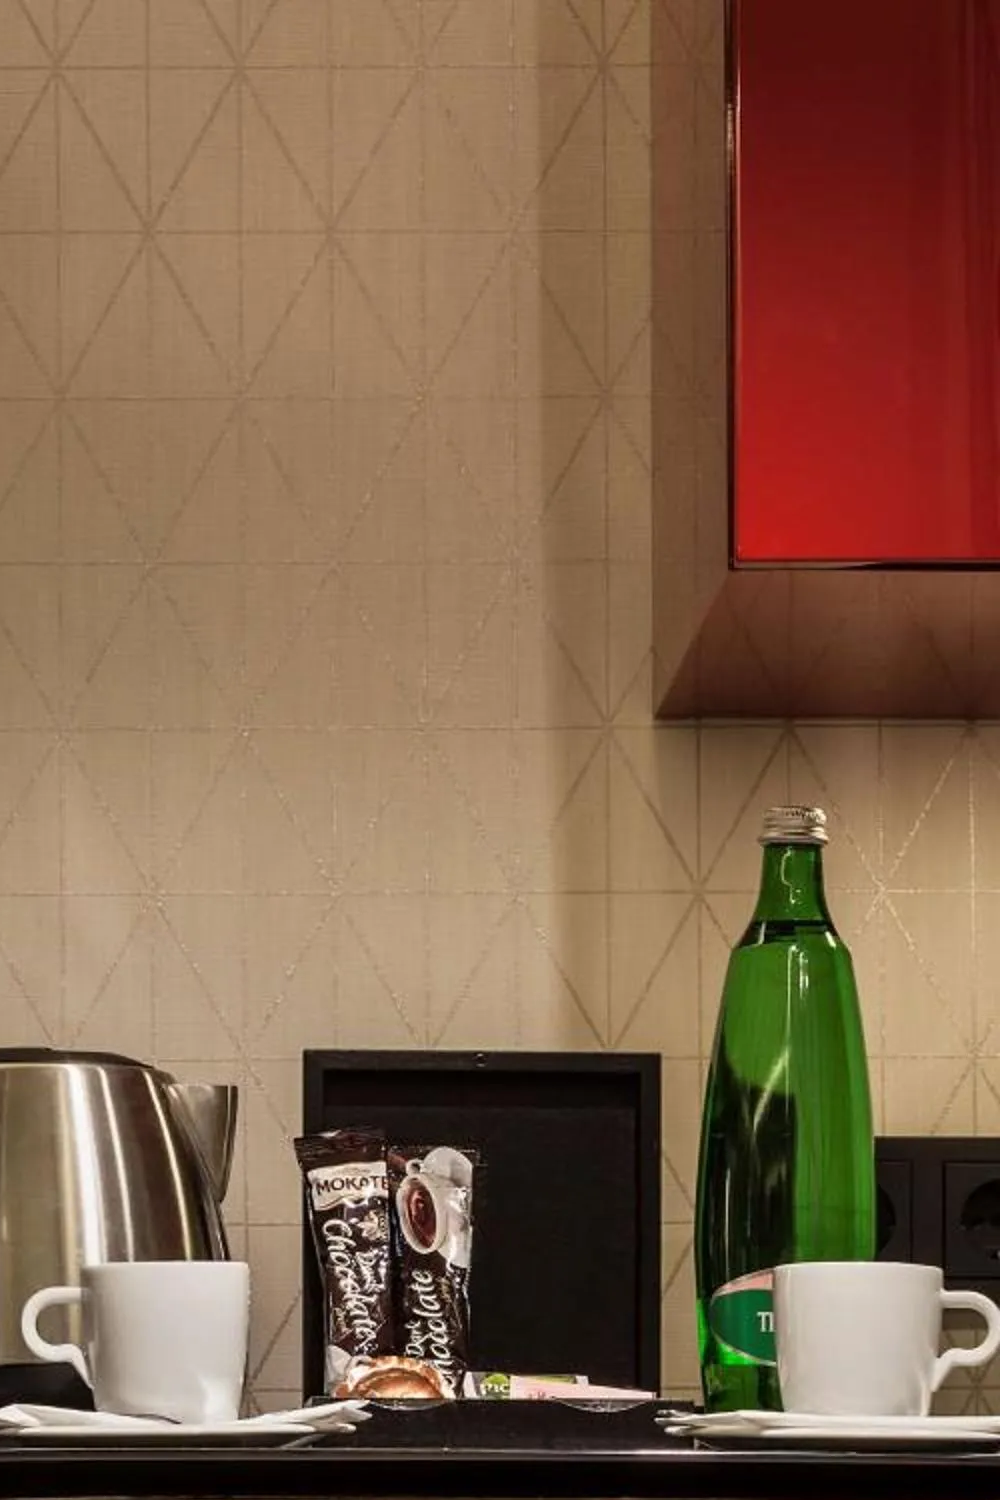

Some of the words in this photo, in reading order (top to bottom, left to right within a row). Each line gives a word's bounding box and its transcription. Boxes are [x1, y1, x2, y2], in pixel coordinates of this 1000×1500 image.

[315, 1174, 390, 1197] MOKATE
[322, 1218, 379, 1346] Chocolate
[404, 1319, 425, 1357] Dark
